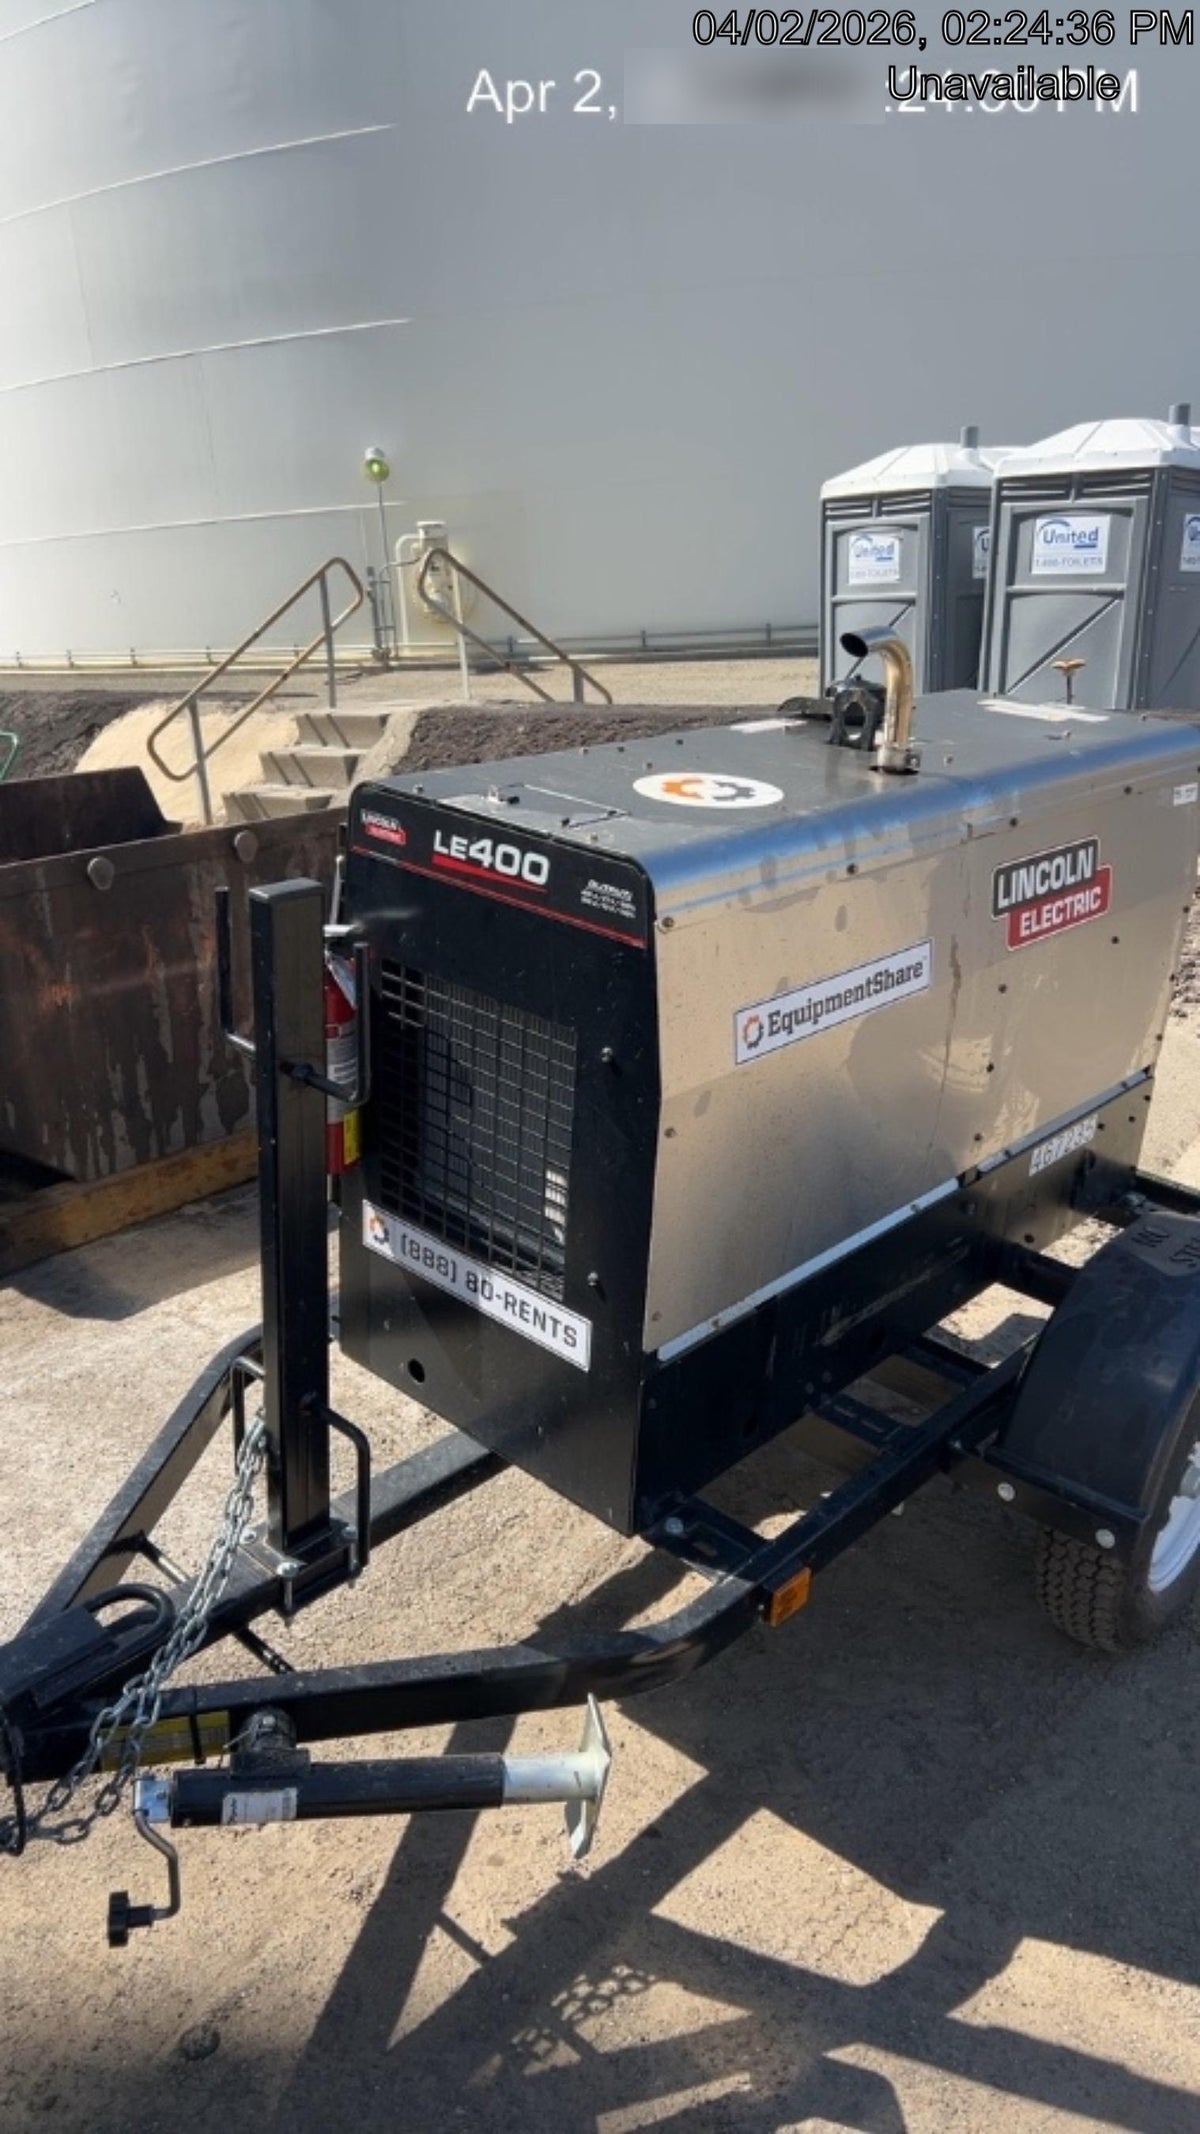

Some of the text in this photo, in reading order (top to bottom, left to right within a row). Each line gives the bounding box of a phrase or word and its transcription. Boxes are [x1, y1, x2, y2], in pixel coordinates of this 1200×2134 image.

[1042, 526, 1099, 545] United
[433, 829, 549, 886] LE400
[998, 845, 1094, 909] LINCOLN
[1019, 886, 1102, 937] ELECTRIC
[768, 961, 923, 1037] EquipmentShare
[466, 1270, 577, 1348] 80-RENTS
